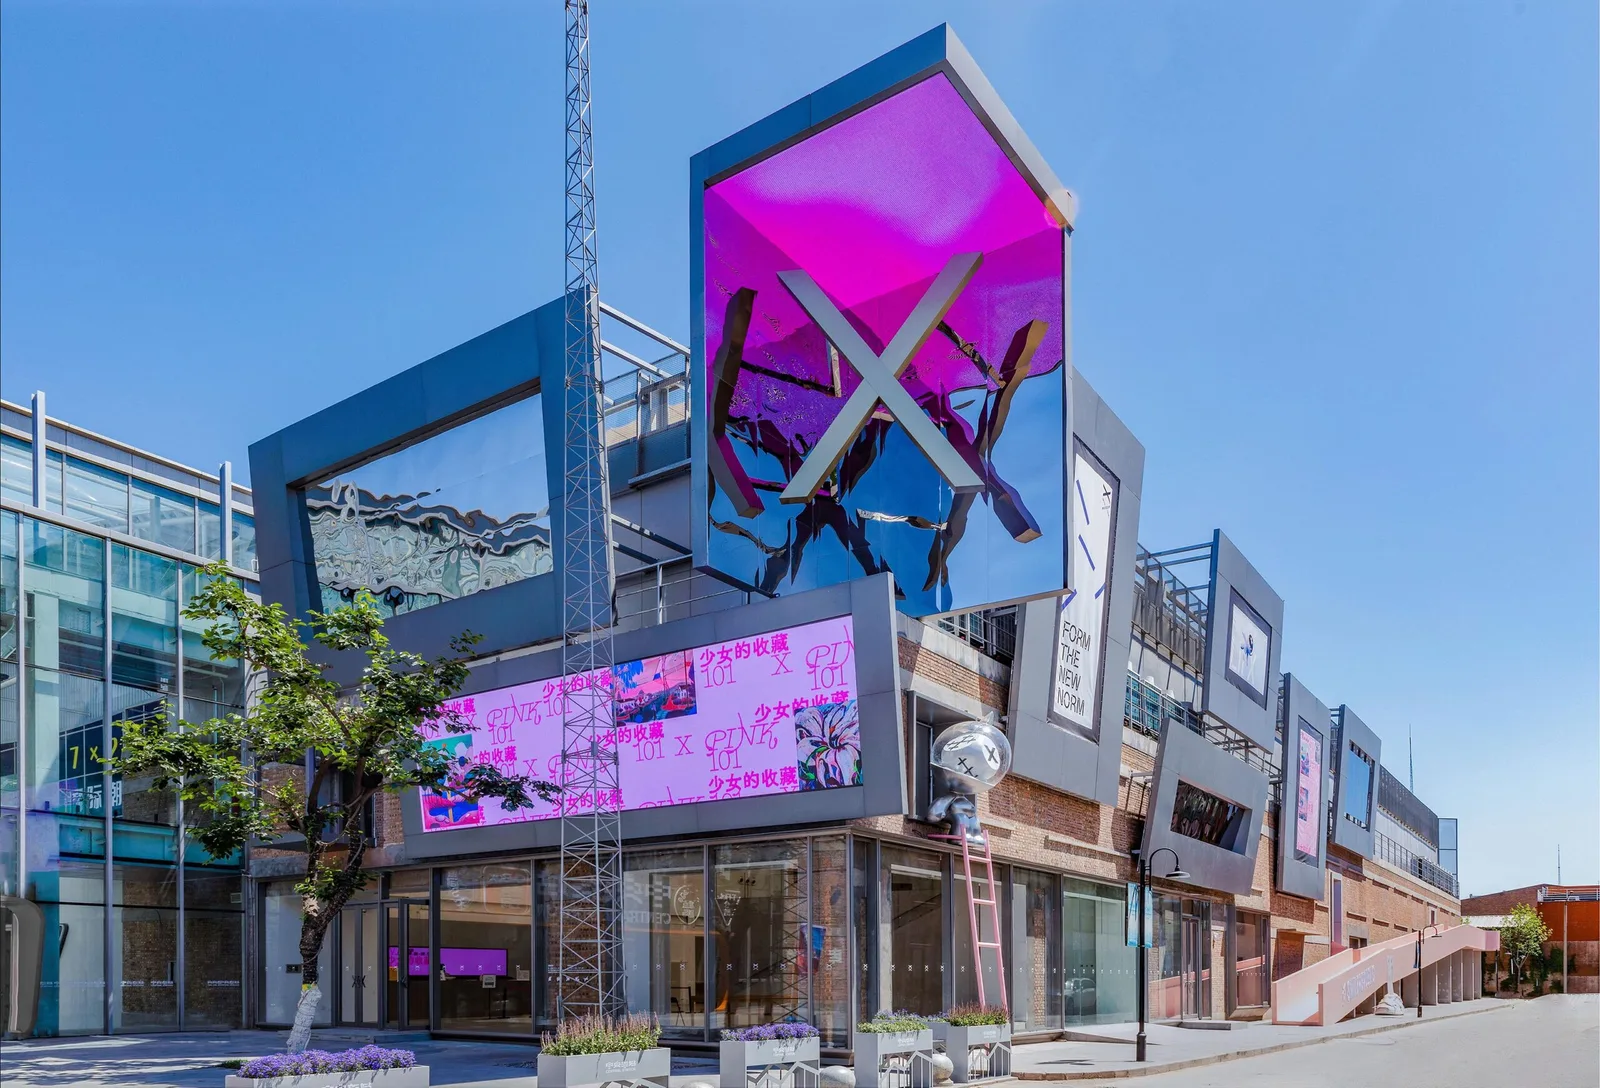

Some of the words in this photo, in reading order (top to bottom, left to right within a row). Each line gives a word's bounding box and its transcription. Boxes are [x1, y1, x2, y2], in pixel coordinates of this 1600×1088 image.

[1062, 620, 1091, 651] FORM
[700, 633, 789, 668] 少女的收藏
[1060, 642, 1081, 668] THE
[701, 661, 736, 688] 101
[771, 651, 793, 676] X
[807, 664, 848, 691] 101
[1058, 665, 1082, 691] NEW
[486, 693, 542, 725] PINK
[1057, 687, 1085, 716] NORM
[488, 724, 516, 746] 101
[633, 739, 665, 762] 101
[674, 734, 694, 757] X
[704, 712, 780, 752] PINK
[707, 749, 743, 772] 101
[708, 765, 798, 795] 少女的收藏
